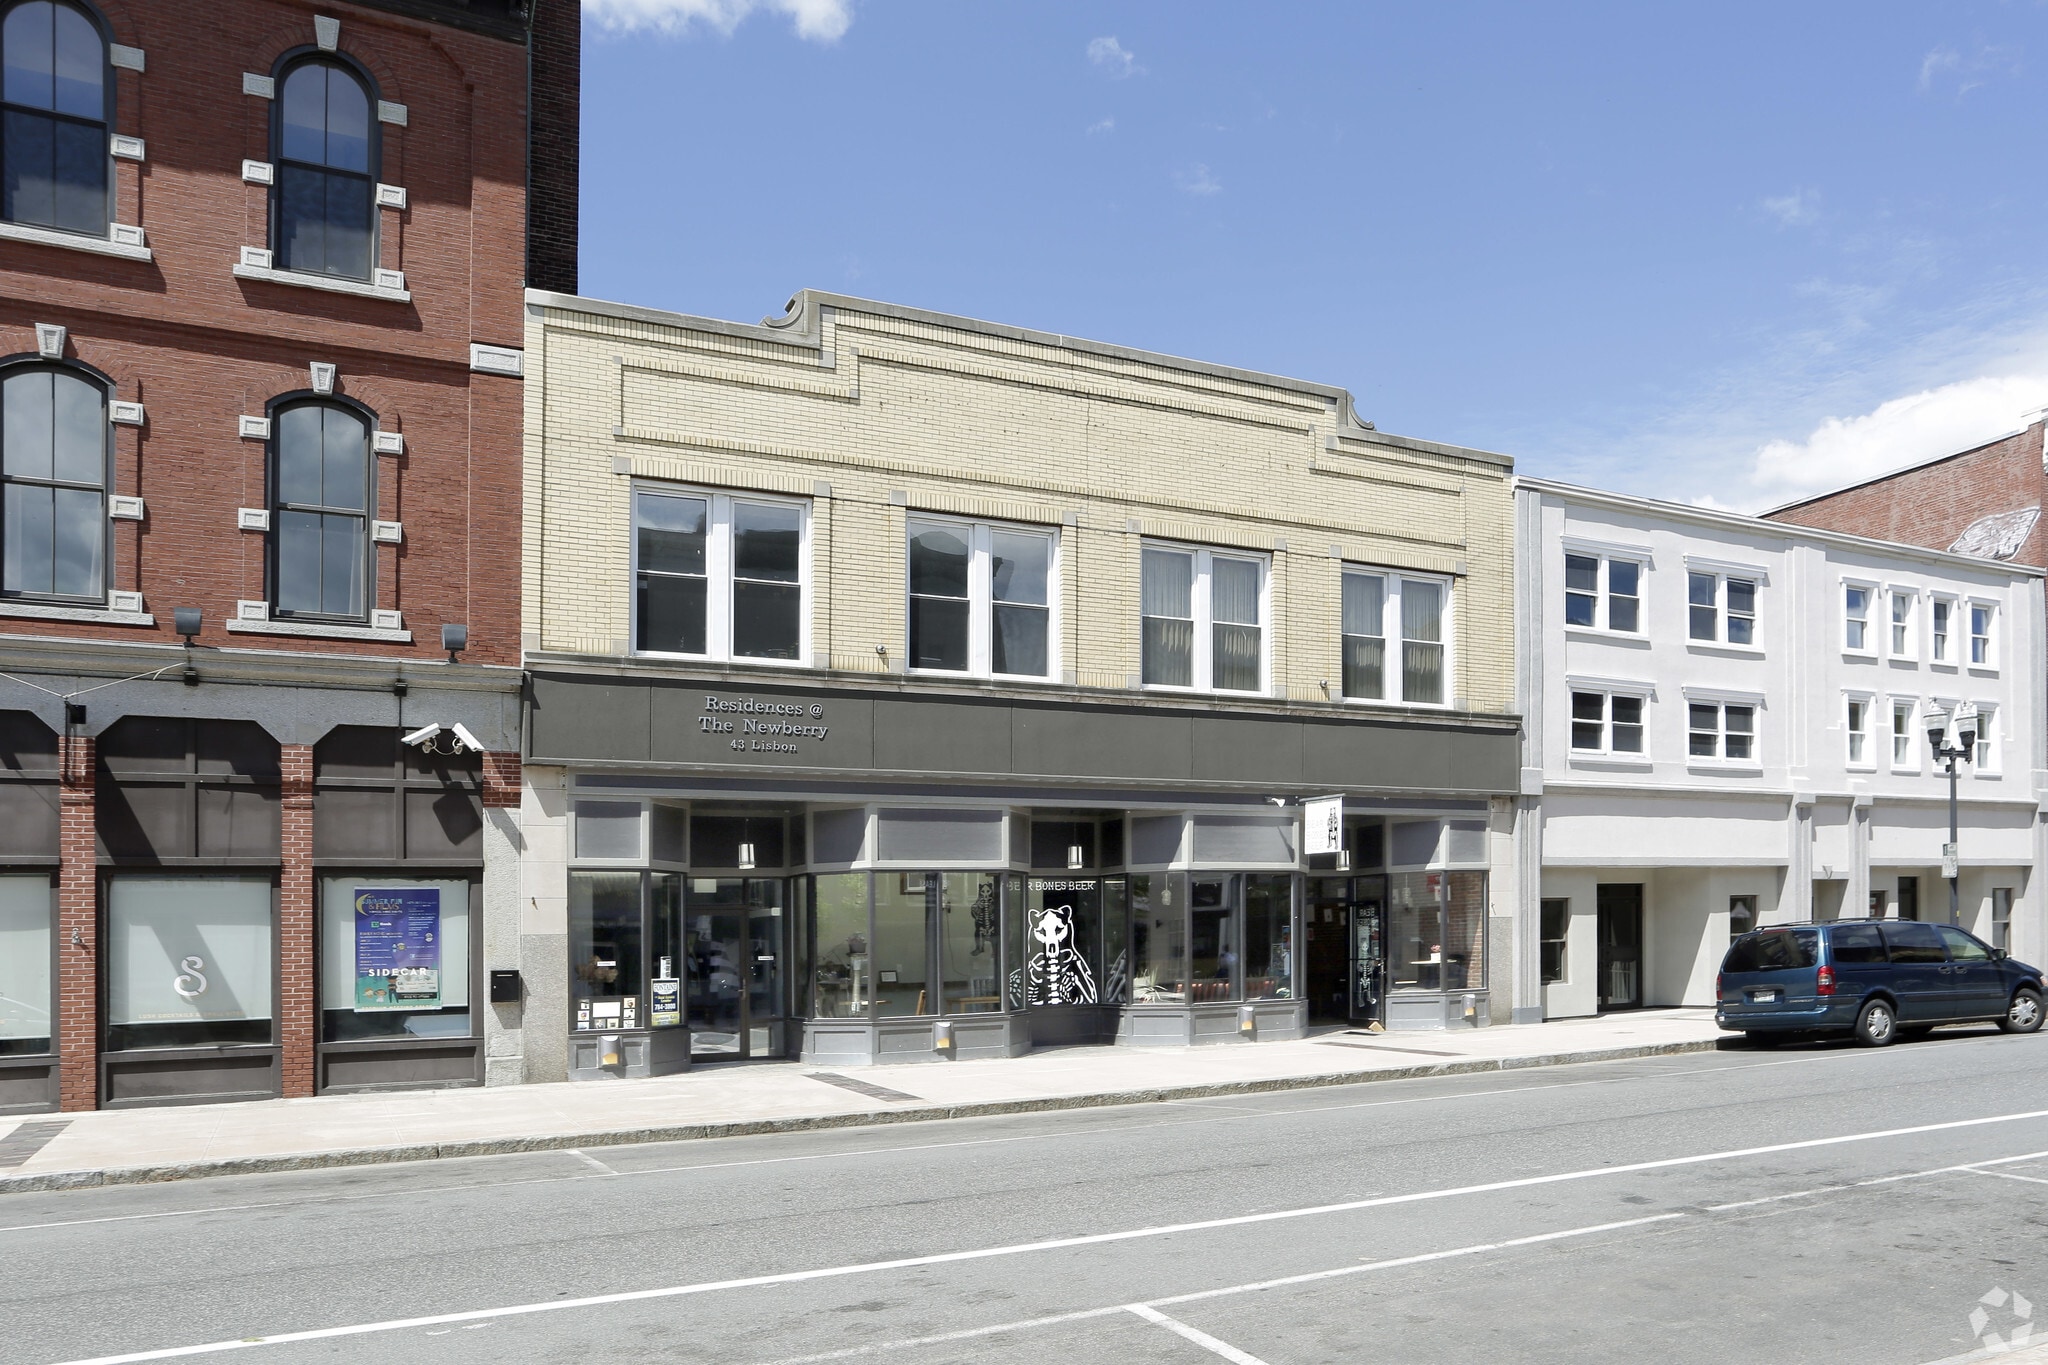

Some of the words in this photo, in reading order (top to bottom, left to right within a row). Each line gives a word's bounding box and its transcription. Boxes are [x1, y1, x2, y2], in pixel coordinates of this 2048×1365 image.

[704, 695, 803, 716] Residences
[809, 703, 823, 717] @
[698, 716, 734, 731] The
[742, 718, 829, 740] Newberry
[730, 739, 745, 750] 43
[751, 739, 798, 752] Lisbon
[1035, 881, 1067, 891] BONES
[1068, 881, 1094, 891] BEER
[173, 955, 207, 997] S
[368, 967, 427, 977] SIDECAR
